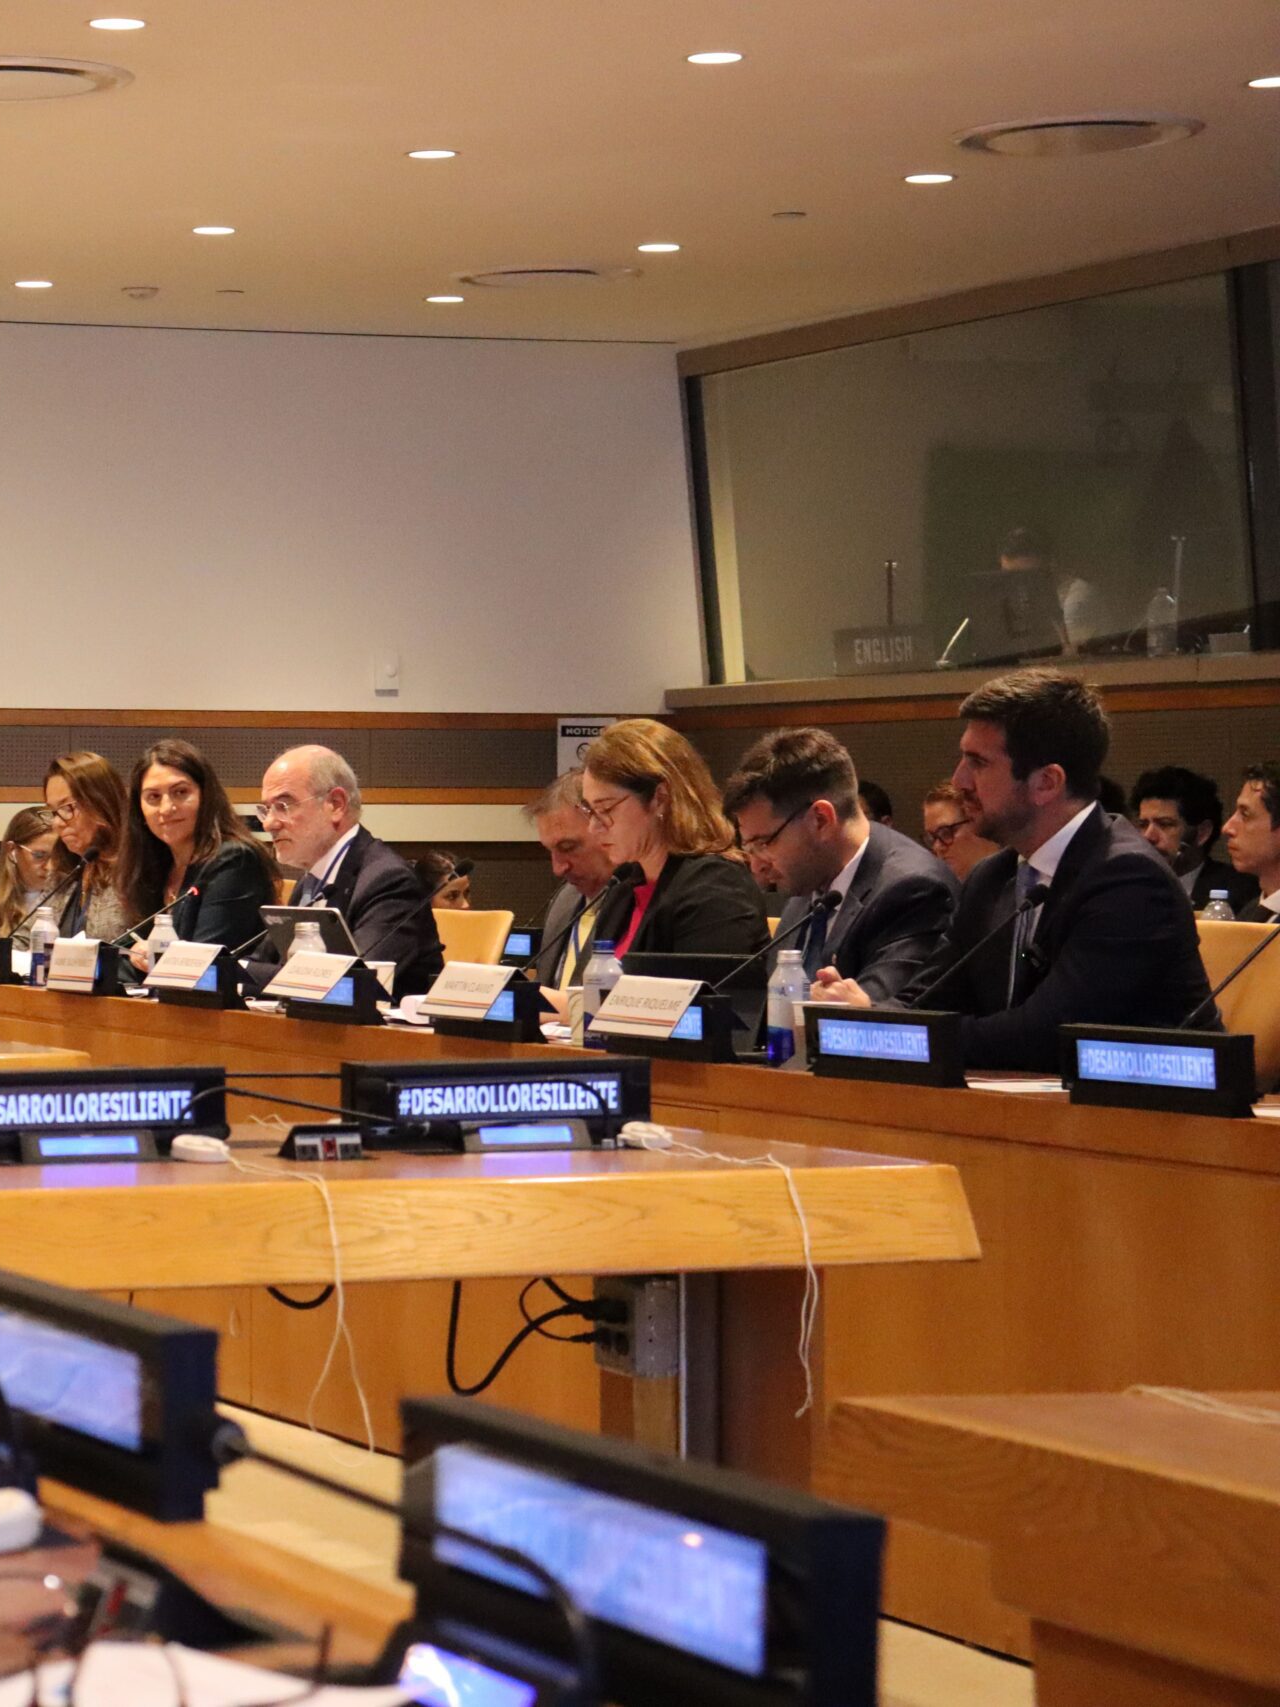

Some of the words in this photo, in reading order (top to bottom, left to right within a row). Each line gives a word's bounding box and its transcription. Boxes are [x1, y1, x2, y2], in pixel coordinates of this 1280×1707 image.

[854, 636, 913, 664] ENGLISH
[565, 727, 602, 736] NOTIC
[609, 994, 643, 1008] ENRIQUE
[821, 1026, 928, 1056] #DESARROLLORESILIENTE
[1081, 1047, 1214, 1083] #DESARROLLORESILIENTE
